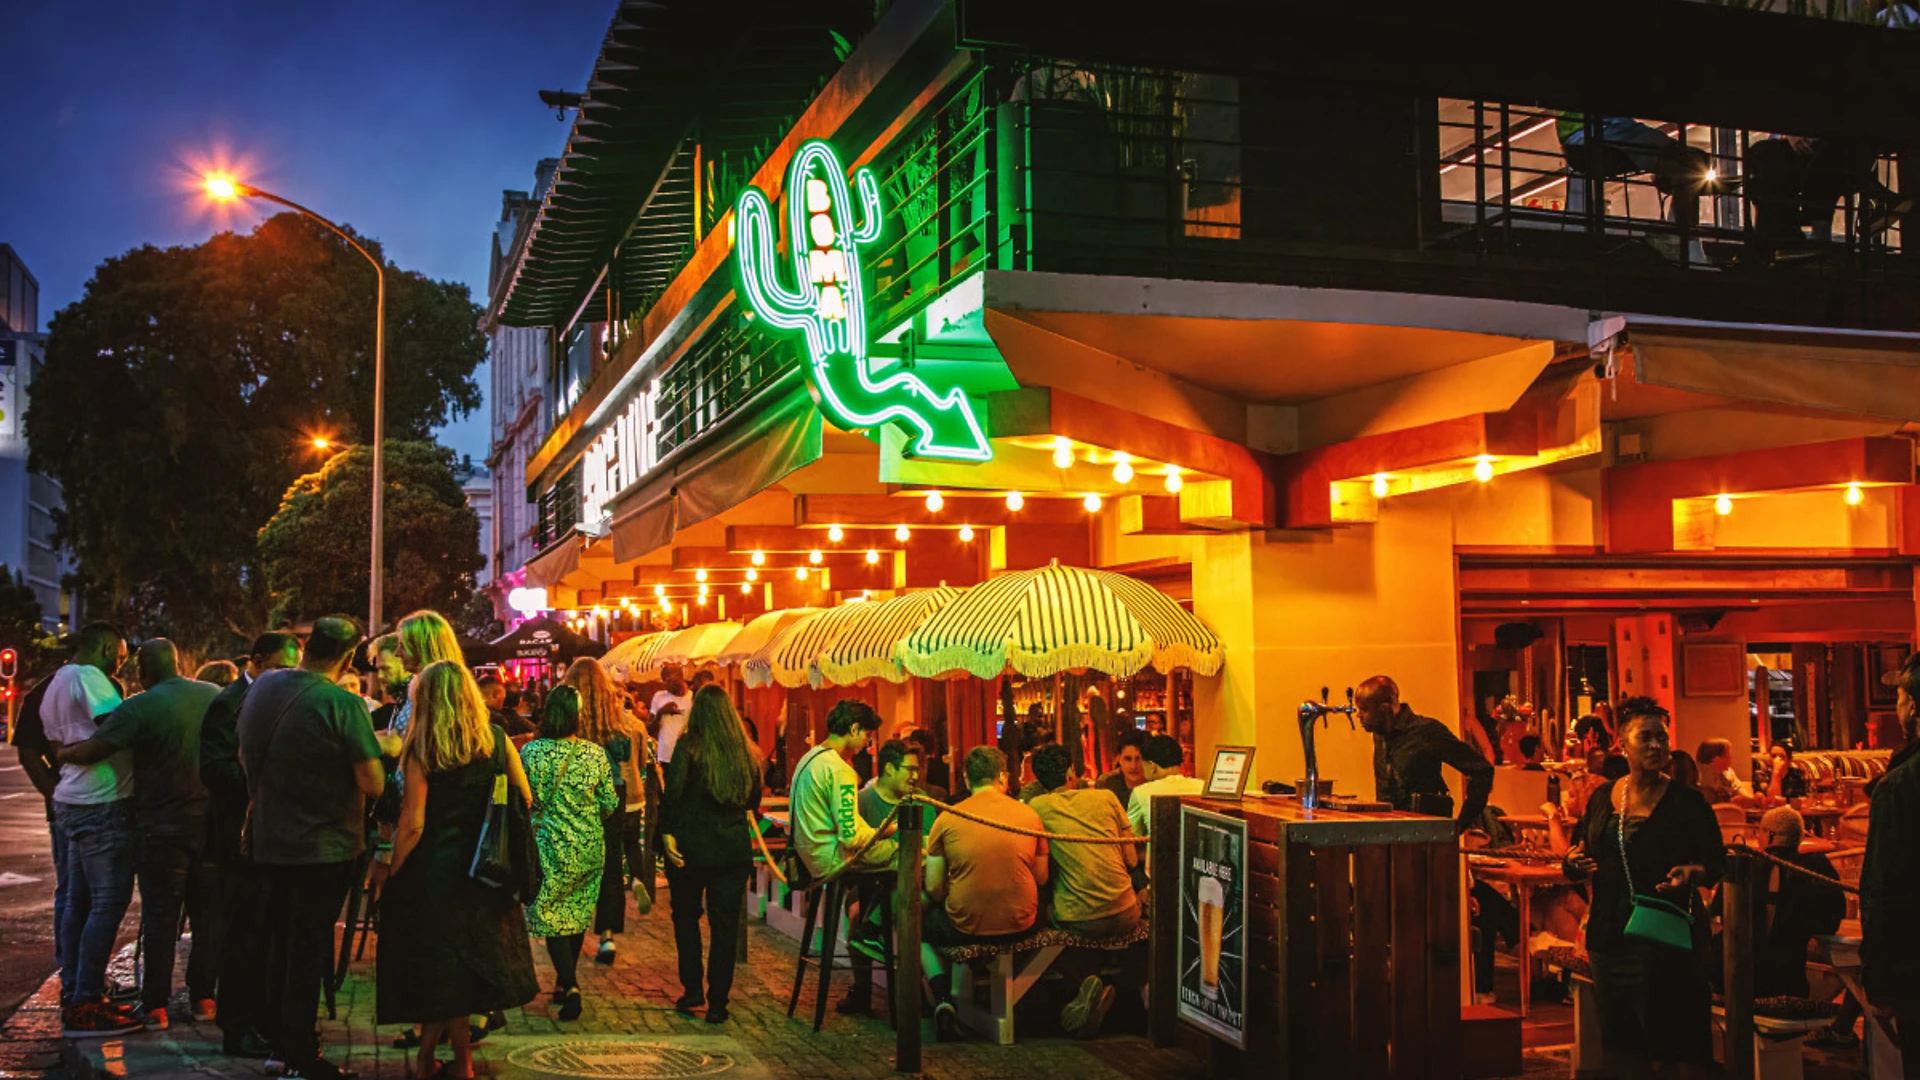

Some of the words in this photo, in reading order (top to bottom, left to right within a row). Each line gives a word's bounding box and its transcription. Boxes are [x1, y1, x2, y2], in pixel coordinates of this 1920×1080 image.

[838, 784, 857, 839] Kappa
[1193, 856, 1219, 877] AVAILABLE
[1219, 864, 1232, 882] HERE
